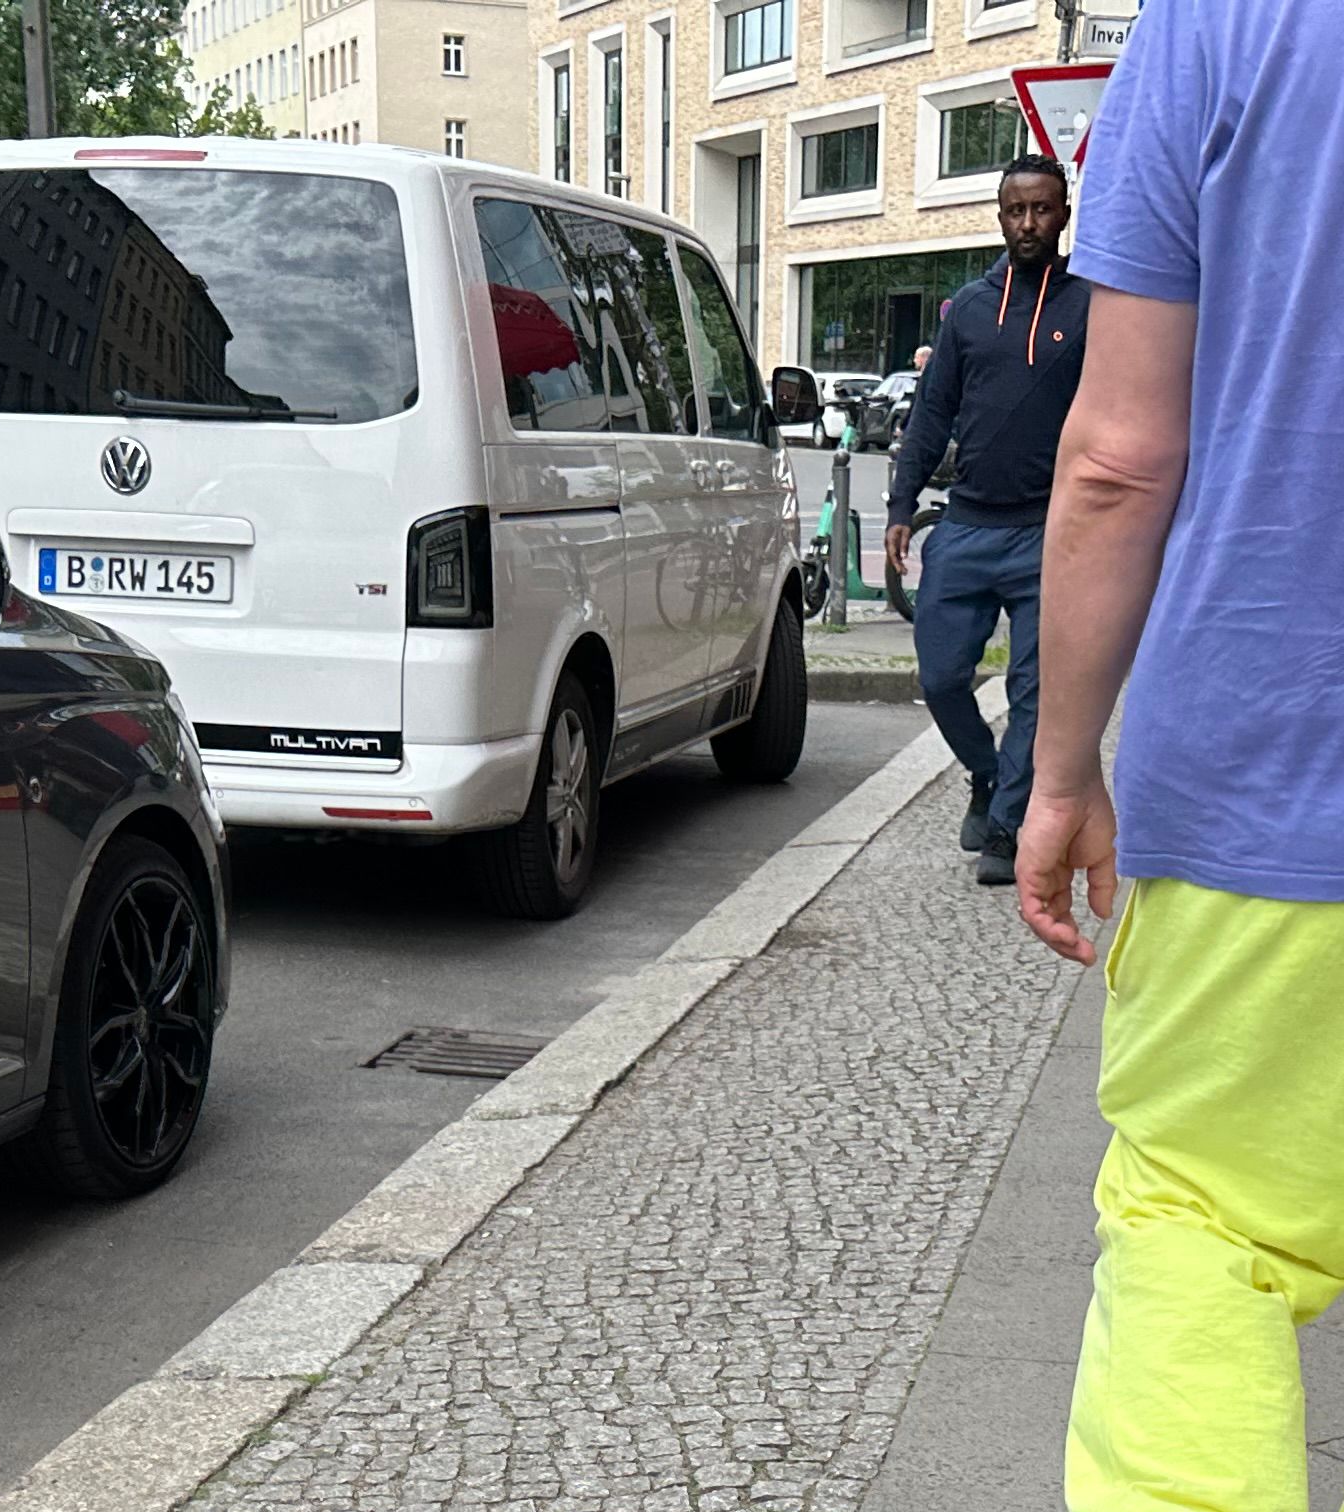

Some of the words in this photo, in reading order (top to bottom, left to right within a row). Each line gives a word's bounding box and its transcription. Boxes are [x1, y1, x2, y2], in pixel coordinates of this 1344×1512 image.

[1091, 24, 1132, 44] Inval
[67, 556, 86, 588] B
[108, 557, 147, 592] RW
[156, 560, 215, 594] 145
[355, 583, 388, 596] TSI
[270, 733, 382, 752] MULTIVAN
